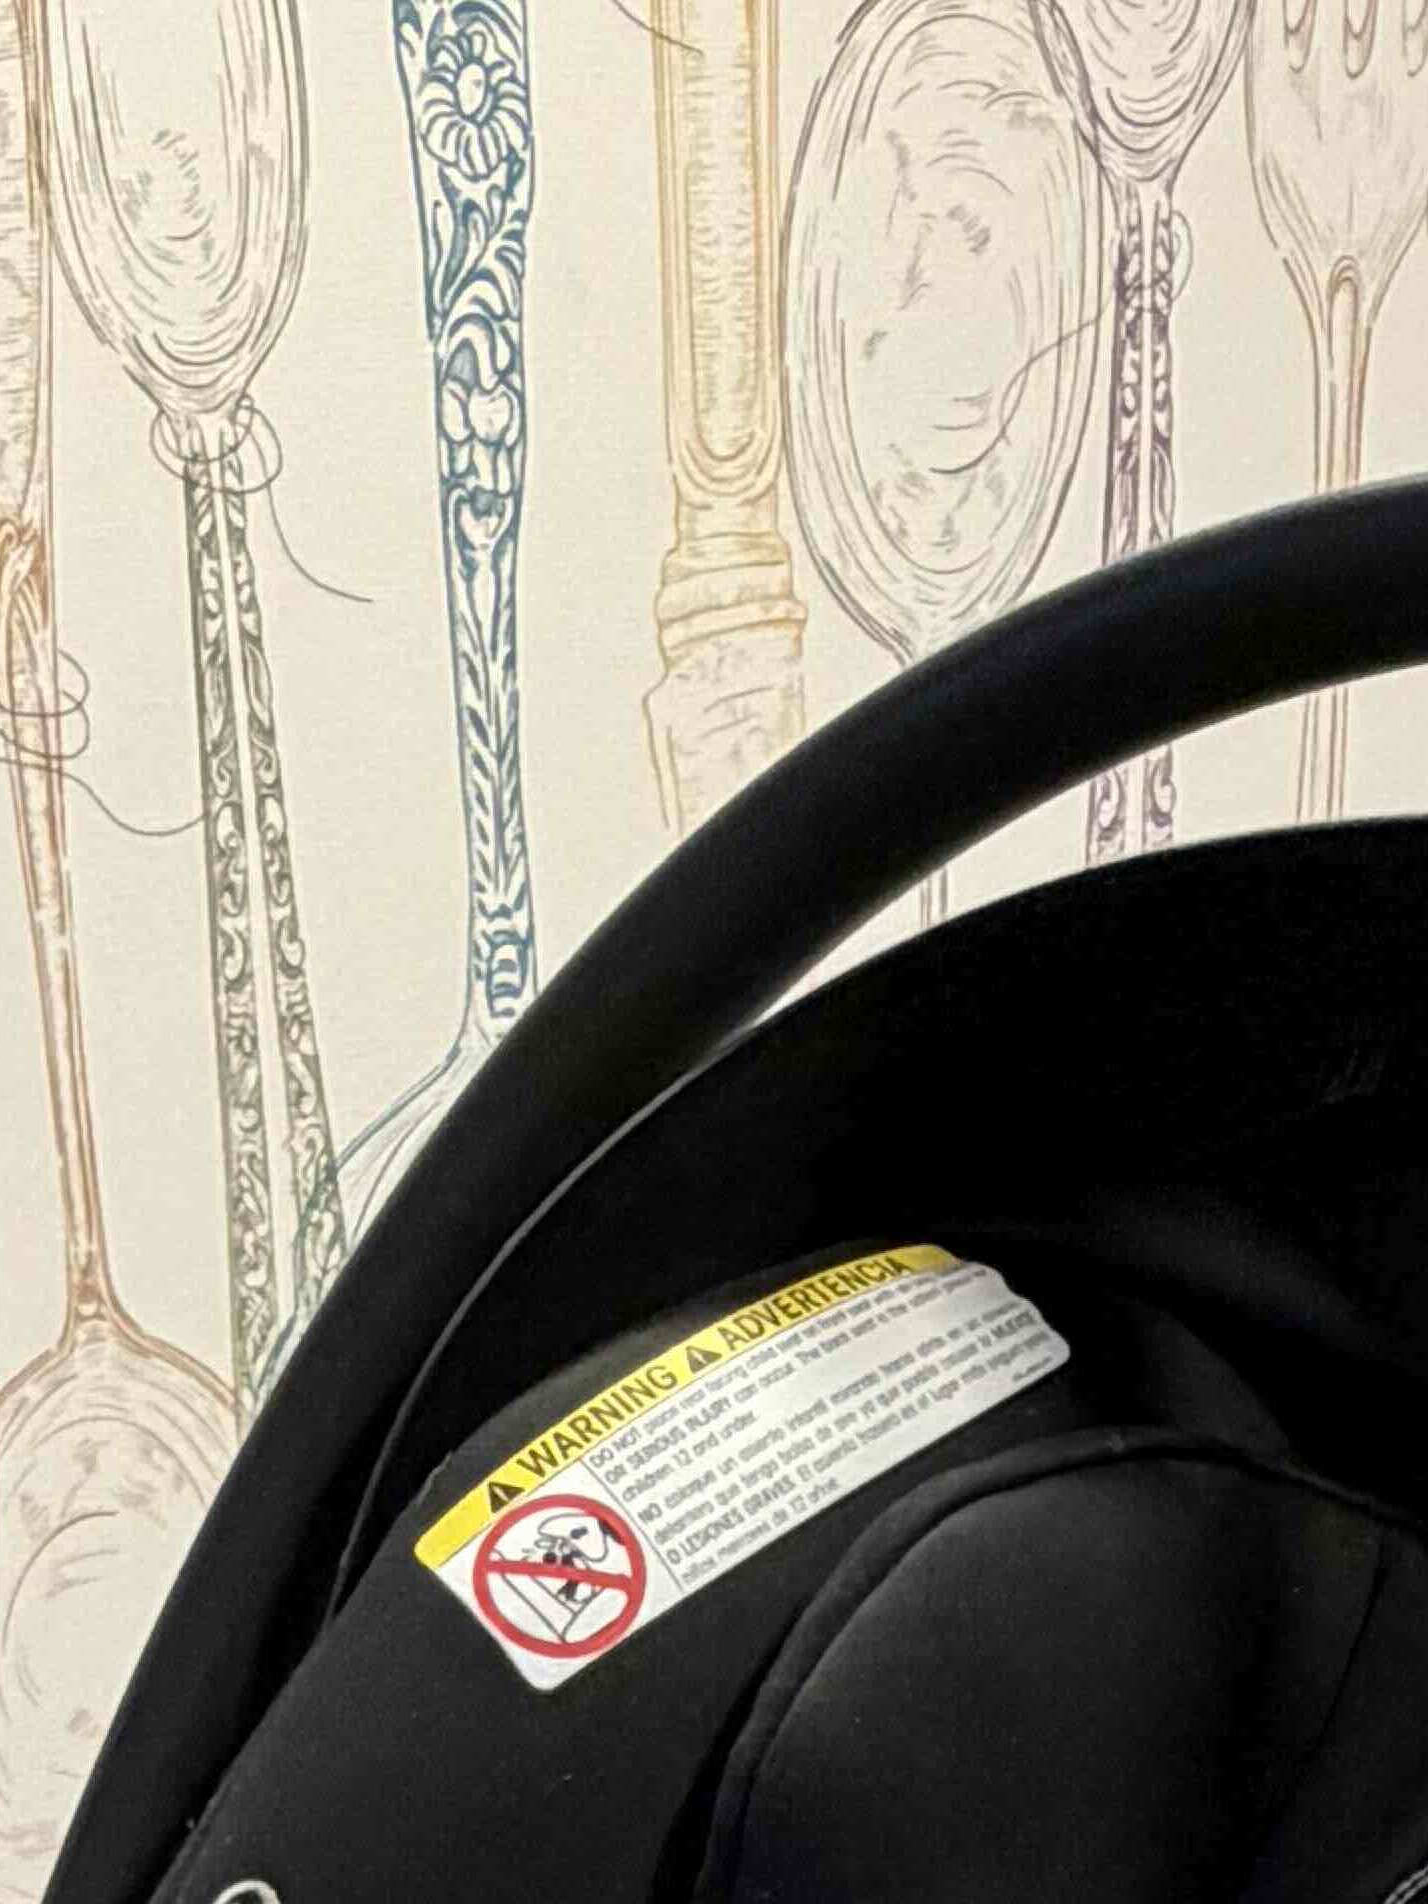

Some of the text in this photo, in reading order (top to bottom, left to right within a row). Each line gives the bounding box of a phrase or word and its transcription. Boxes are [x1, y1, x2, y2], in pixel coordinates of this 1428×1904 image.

[515, 1256, 913, 1480] WARNING ADVERTENCIA
[672, 1448, 693, 1467] 12
